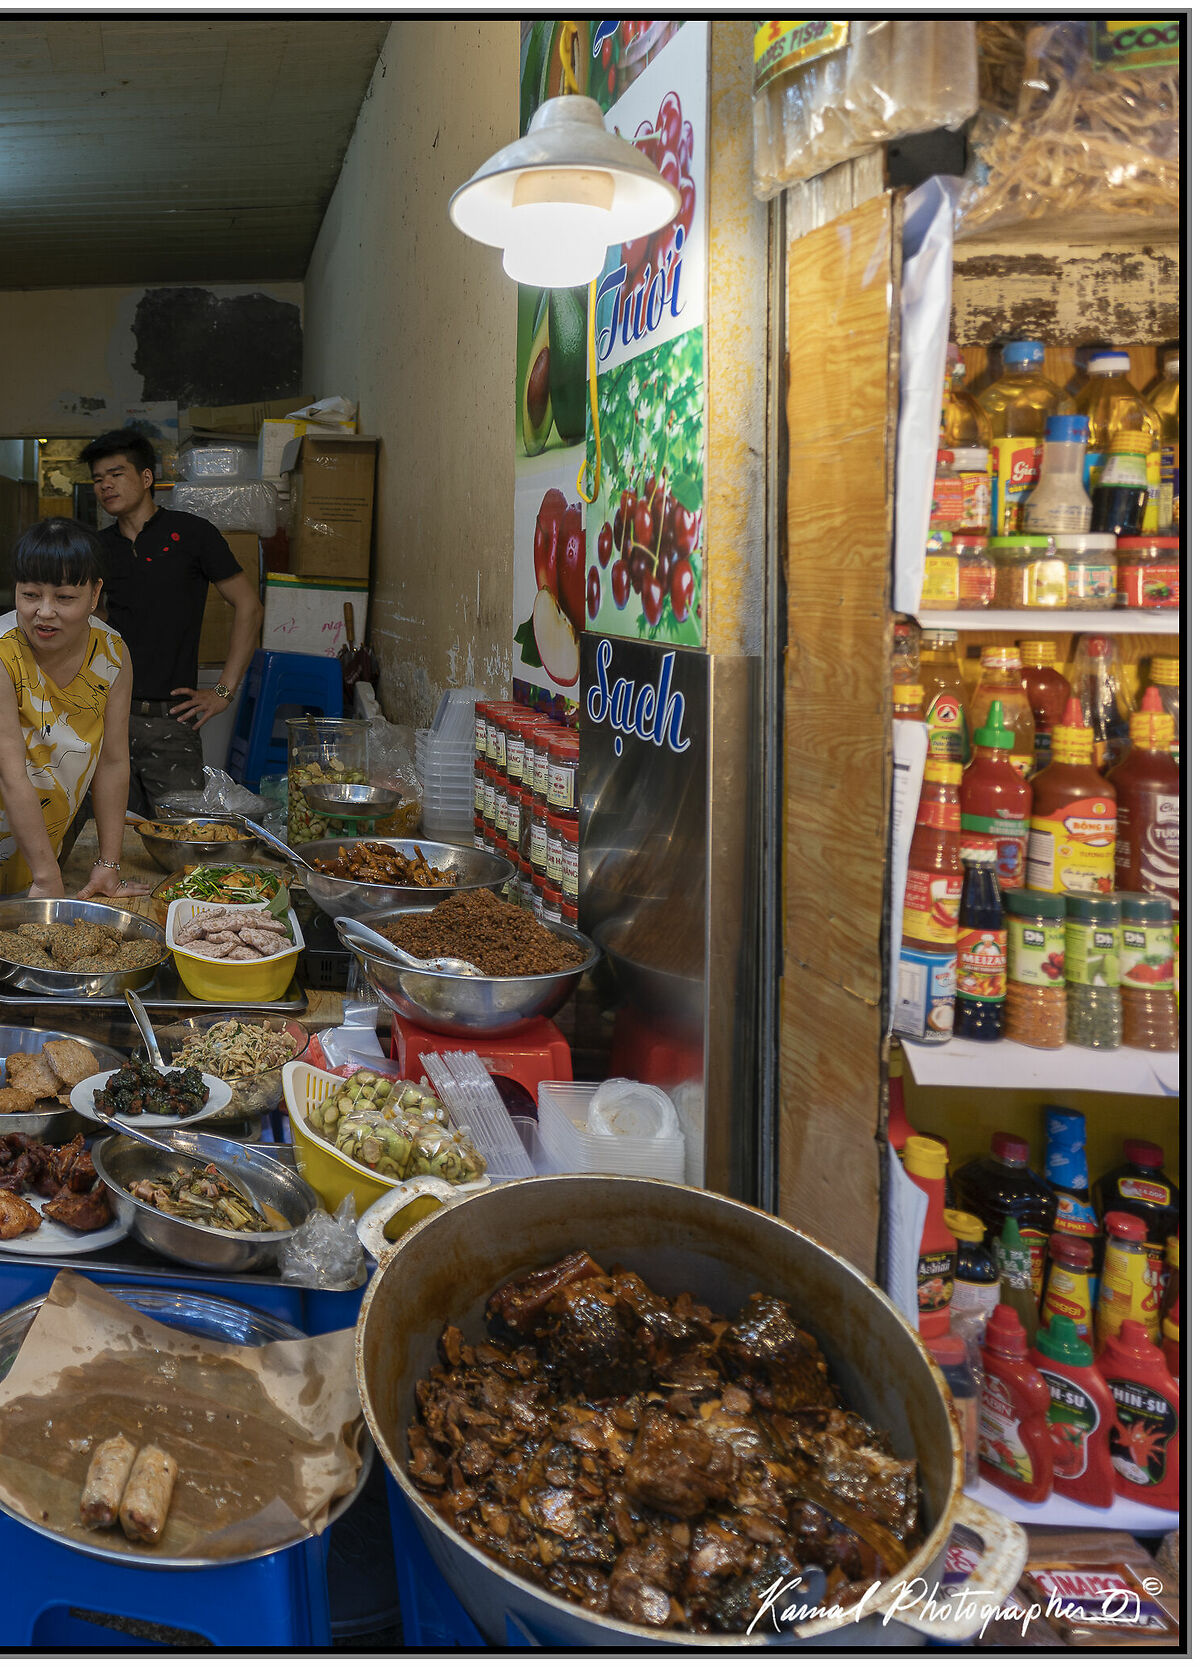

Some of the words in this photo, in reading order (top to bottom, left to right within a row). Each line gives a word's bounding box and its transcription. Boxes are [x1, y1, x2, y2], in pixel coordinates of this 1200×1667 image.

[595, 224, 687, 362] Tươi
[587, 639, 692, 758] Sạch
[1108, 1385, 1168, 1415] HIN-SU
